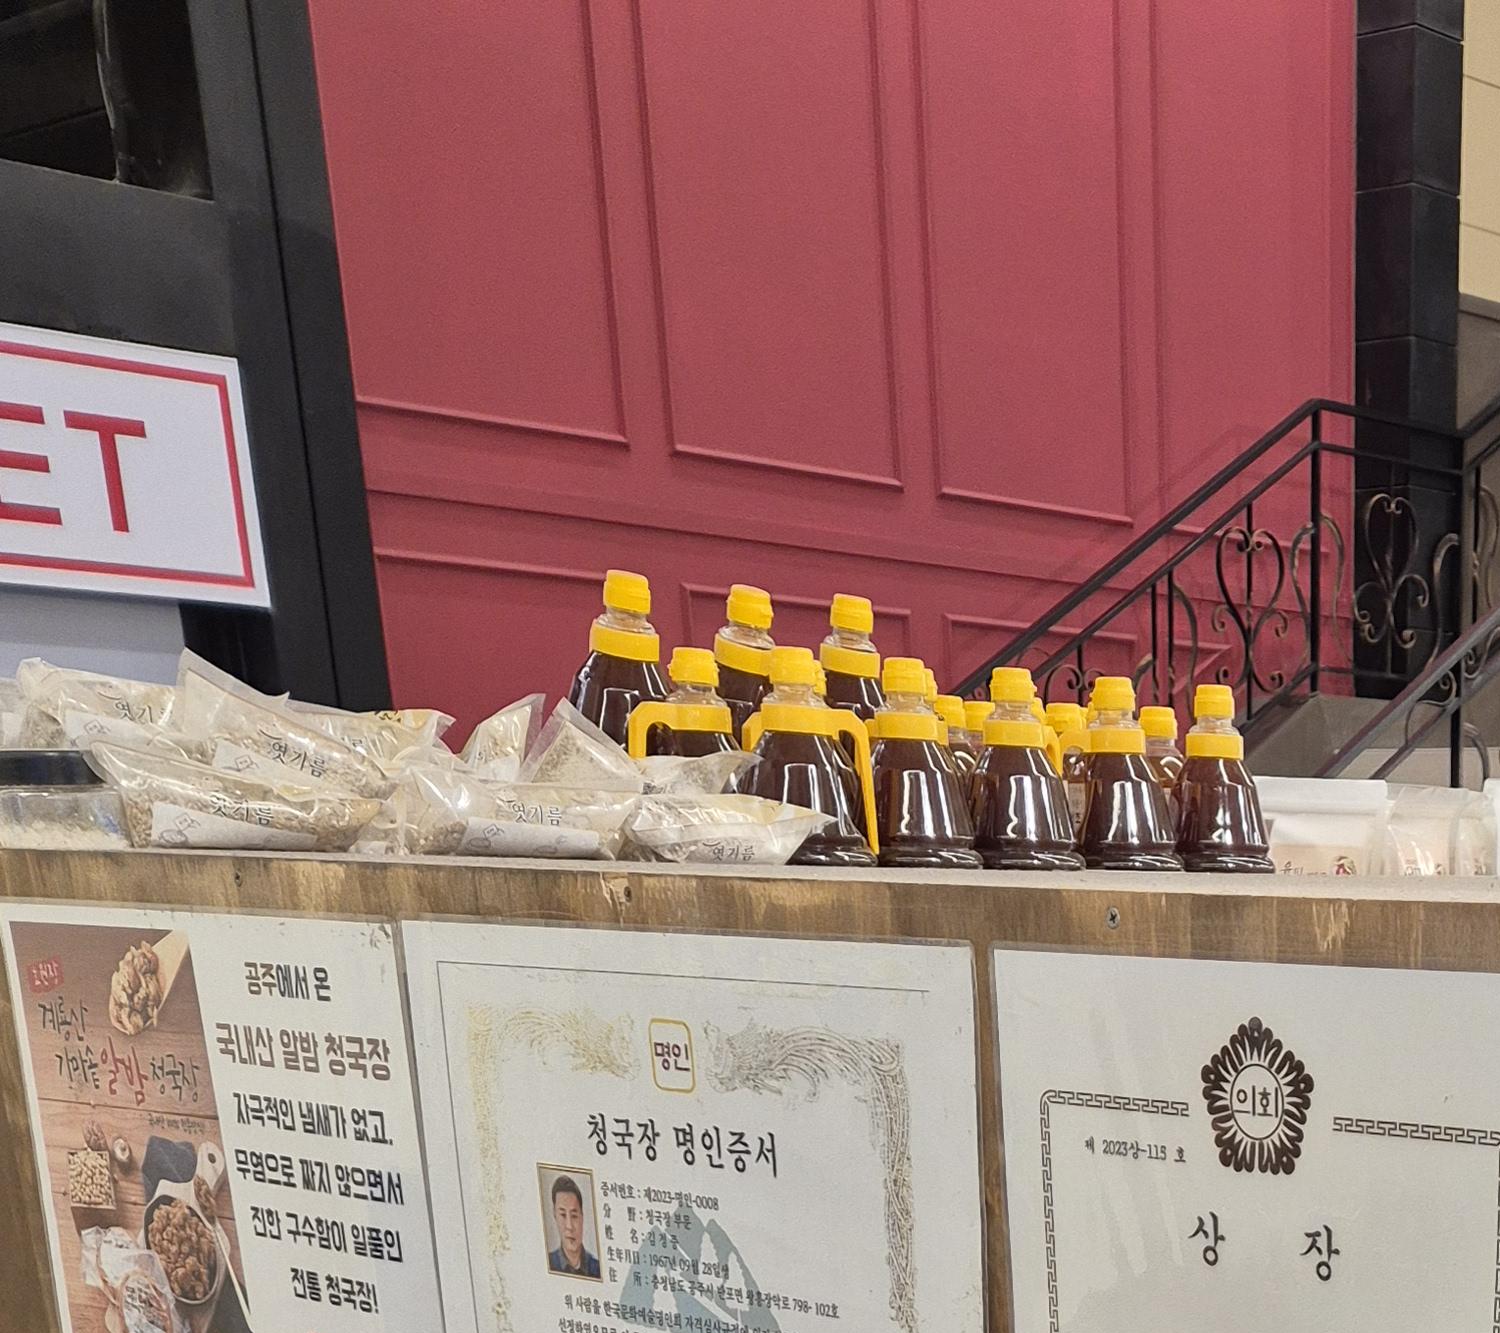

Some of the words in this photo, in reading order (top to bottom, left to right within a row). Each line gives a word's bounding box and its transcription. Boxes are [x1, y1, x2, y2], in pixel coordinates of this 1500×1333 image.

[271, 739, 327, 778] 엿기름
[511, 801, 562, 826] 엿기름
[711, 844, 756, 862] 엿기름
[245, 962, 309, 1000] 공주에서
[313, 968, 331, 1001] 온
[38, 996, 88, 1041] 계룡산
[100, 1035, 148, 1106] 알밤
[150, 1053, 199, 1102] 청국장
[216, 1023, 275, 1068] 국내산
[280, 1029, 320, 1073] 알밤
[324, 1033, 390, 1081] 청국장
[654, 1038, 692, 1076] 명인
[233, 1093, 296, 1131] 자극적인
[298, 1101, 347, 1139] 냄새가
[1232, 1084, 1279, 1119] 의회
[588, 1113, 660, 1161] 청국장
[673, 1123, 776, 1178] 명인증서
[235, 1149, 297, 1188] 무염으로
[299, 1159, 331, 1194] 짜지
[335, 1165, 404, 1205] 않으면서
[251, 1206, 281, 1240] 진한
[286, 1212, 347, 1253] 구수함이
[351, 1224, 403, 1263] 일품인
[1188, 1212, 1225, 1266] 상
[1300, 1225, 1340, 1281] 장
[291, 1268, 321, 1302] 전통
[325, 1274, 378, 1313] 청국장!
